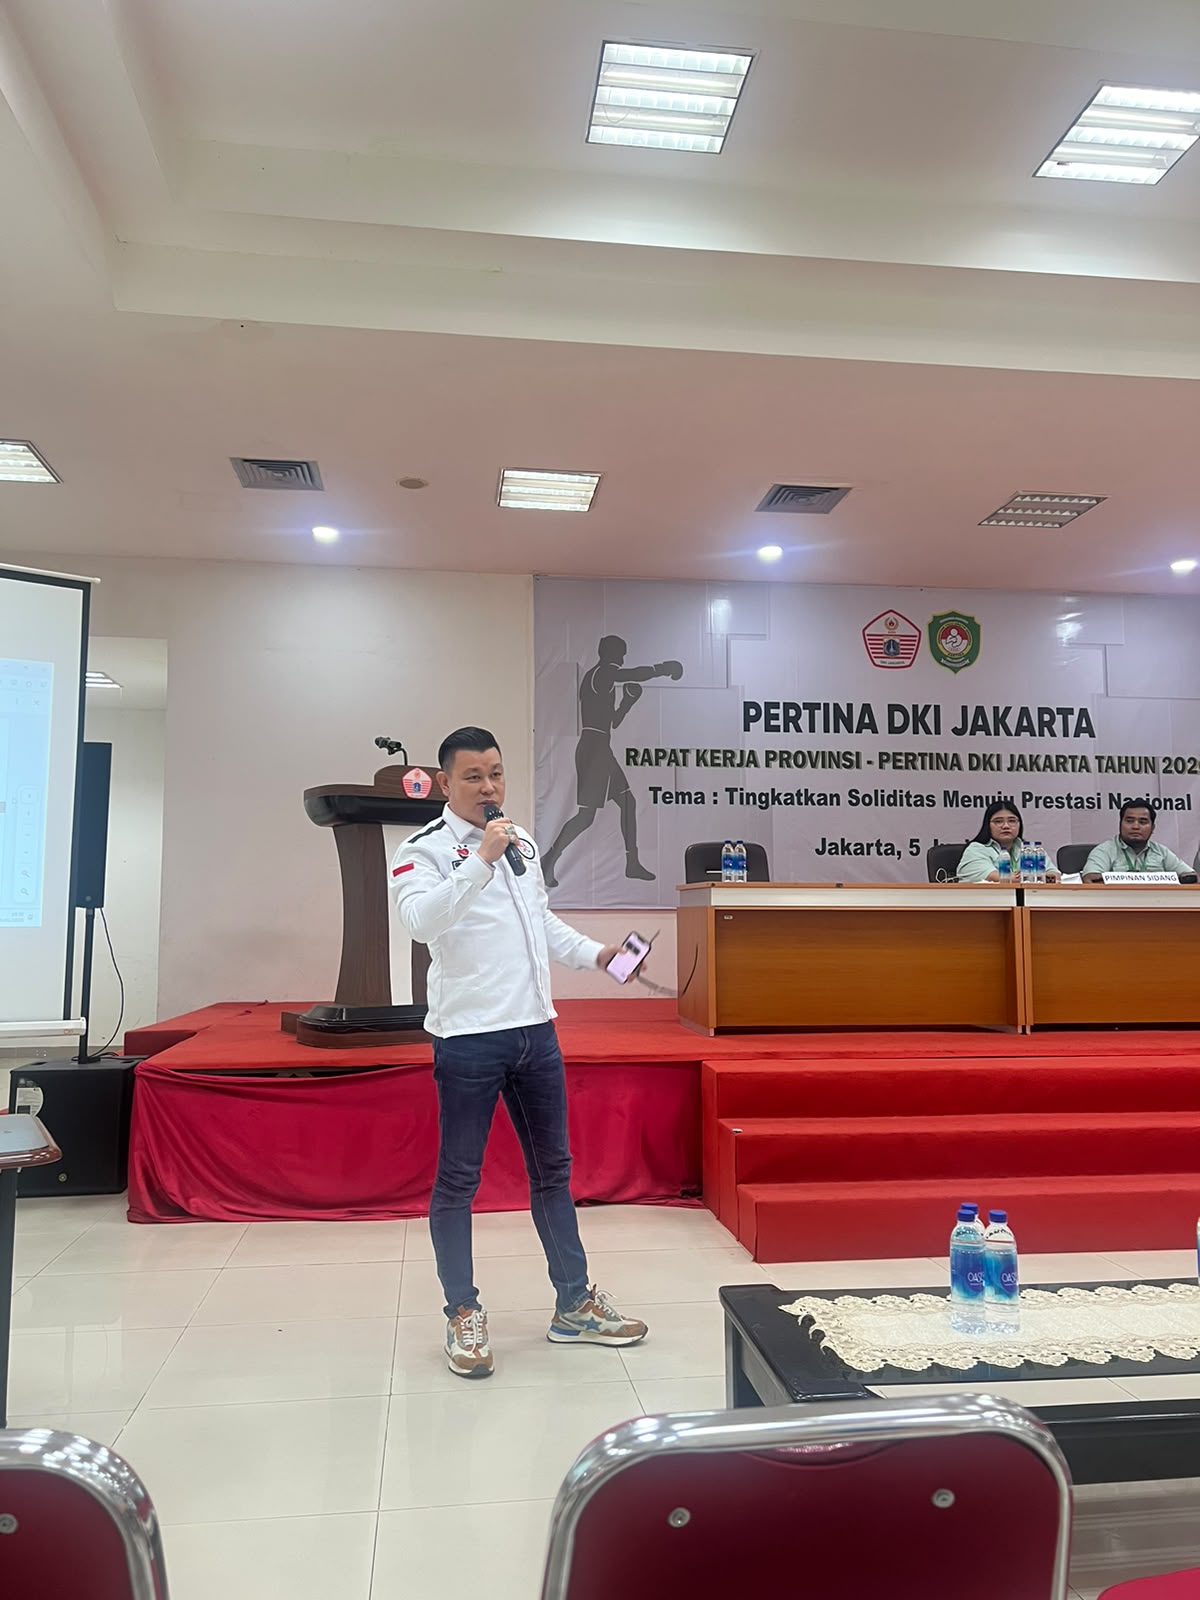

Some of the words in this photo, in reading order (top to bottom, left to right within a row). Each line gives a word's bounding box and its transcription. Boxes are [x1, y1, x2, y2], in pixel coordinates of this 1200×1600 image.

[743, 701, 879, 733] PERTINA
[887, 703, 942, 735] DKI
[951, 705, 1096, 738] JAKARTA
[625, 748, 691, 767] RAPAT
[695, 749, 760, 768] KERJA
[764, 750, 862, 769] PROVINSI
[878, 751, 964, 771] PERTINA
[968, 753, 1002, 772] DKI
[1007, 753, 1091, 773] JAKARTA
[1095, 755, 1157, 774] TAHUN
[1162, 756, 1200, 774] 202
[649, 786, 706, 805] Tema
[725, 787, 841, 810] Tingkatkan
[847, 788, 937, 808] Soliditas
[1021, 791, 1101, 809] Prestasi
[1108, 792, 1192, 811] Nional
[815, 837, 902, 860] Jakarta,
[908, 839, 921, 857] 5
[1105, 874, 1145, 882] PIMPINAN
[1147, 874, 1178, 882] SIDANG
